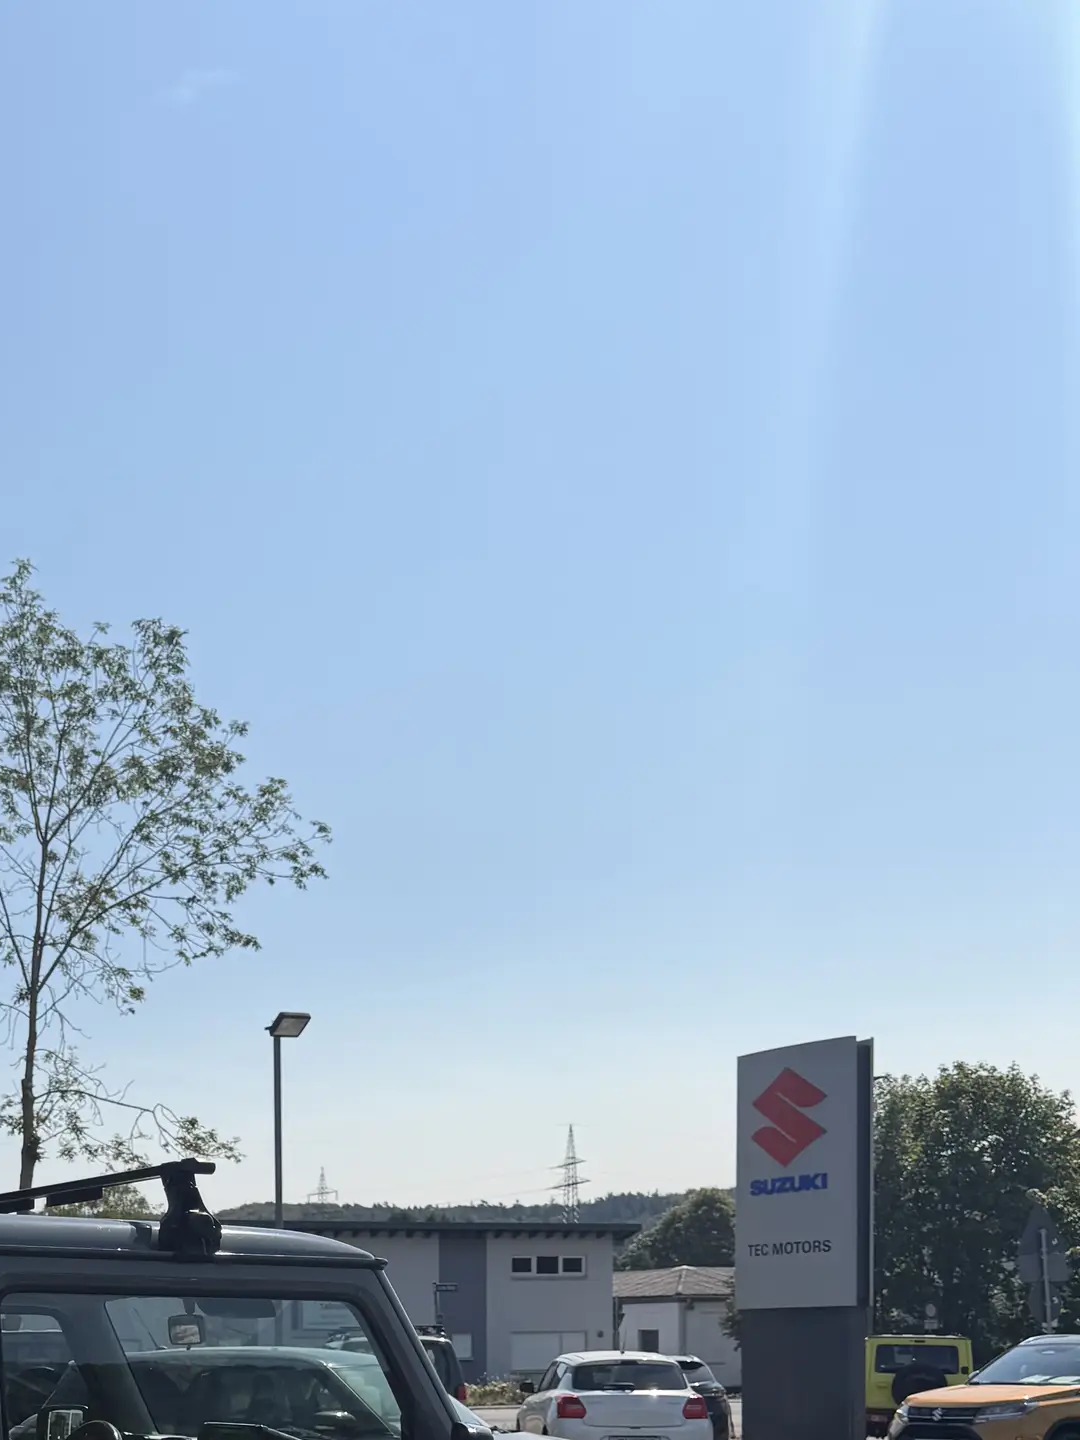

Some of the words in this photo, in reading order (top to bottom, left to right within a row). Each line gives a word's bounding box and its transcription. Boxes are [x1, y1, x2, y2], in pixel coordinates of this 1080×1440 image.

[749, 1172, 828, 1196] SUZUKI
[747, 1243, 769, 1257] TEC
[772, 1239, 832, 1256] MOTORS
